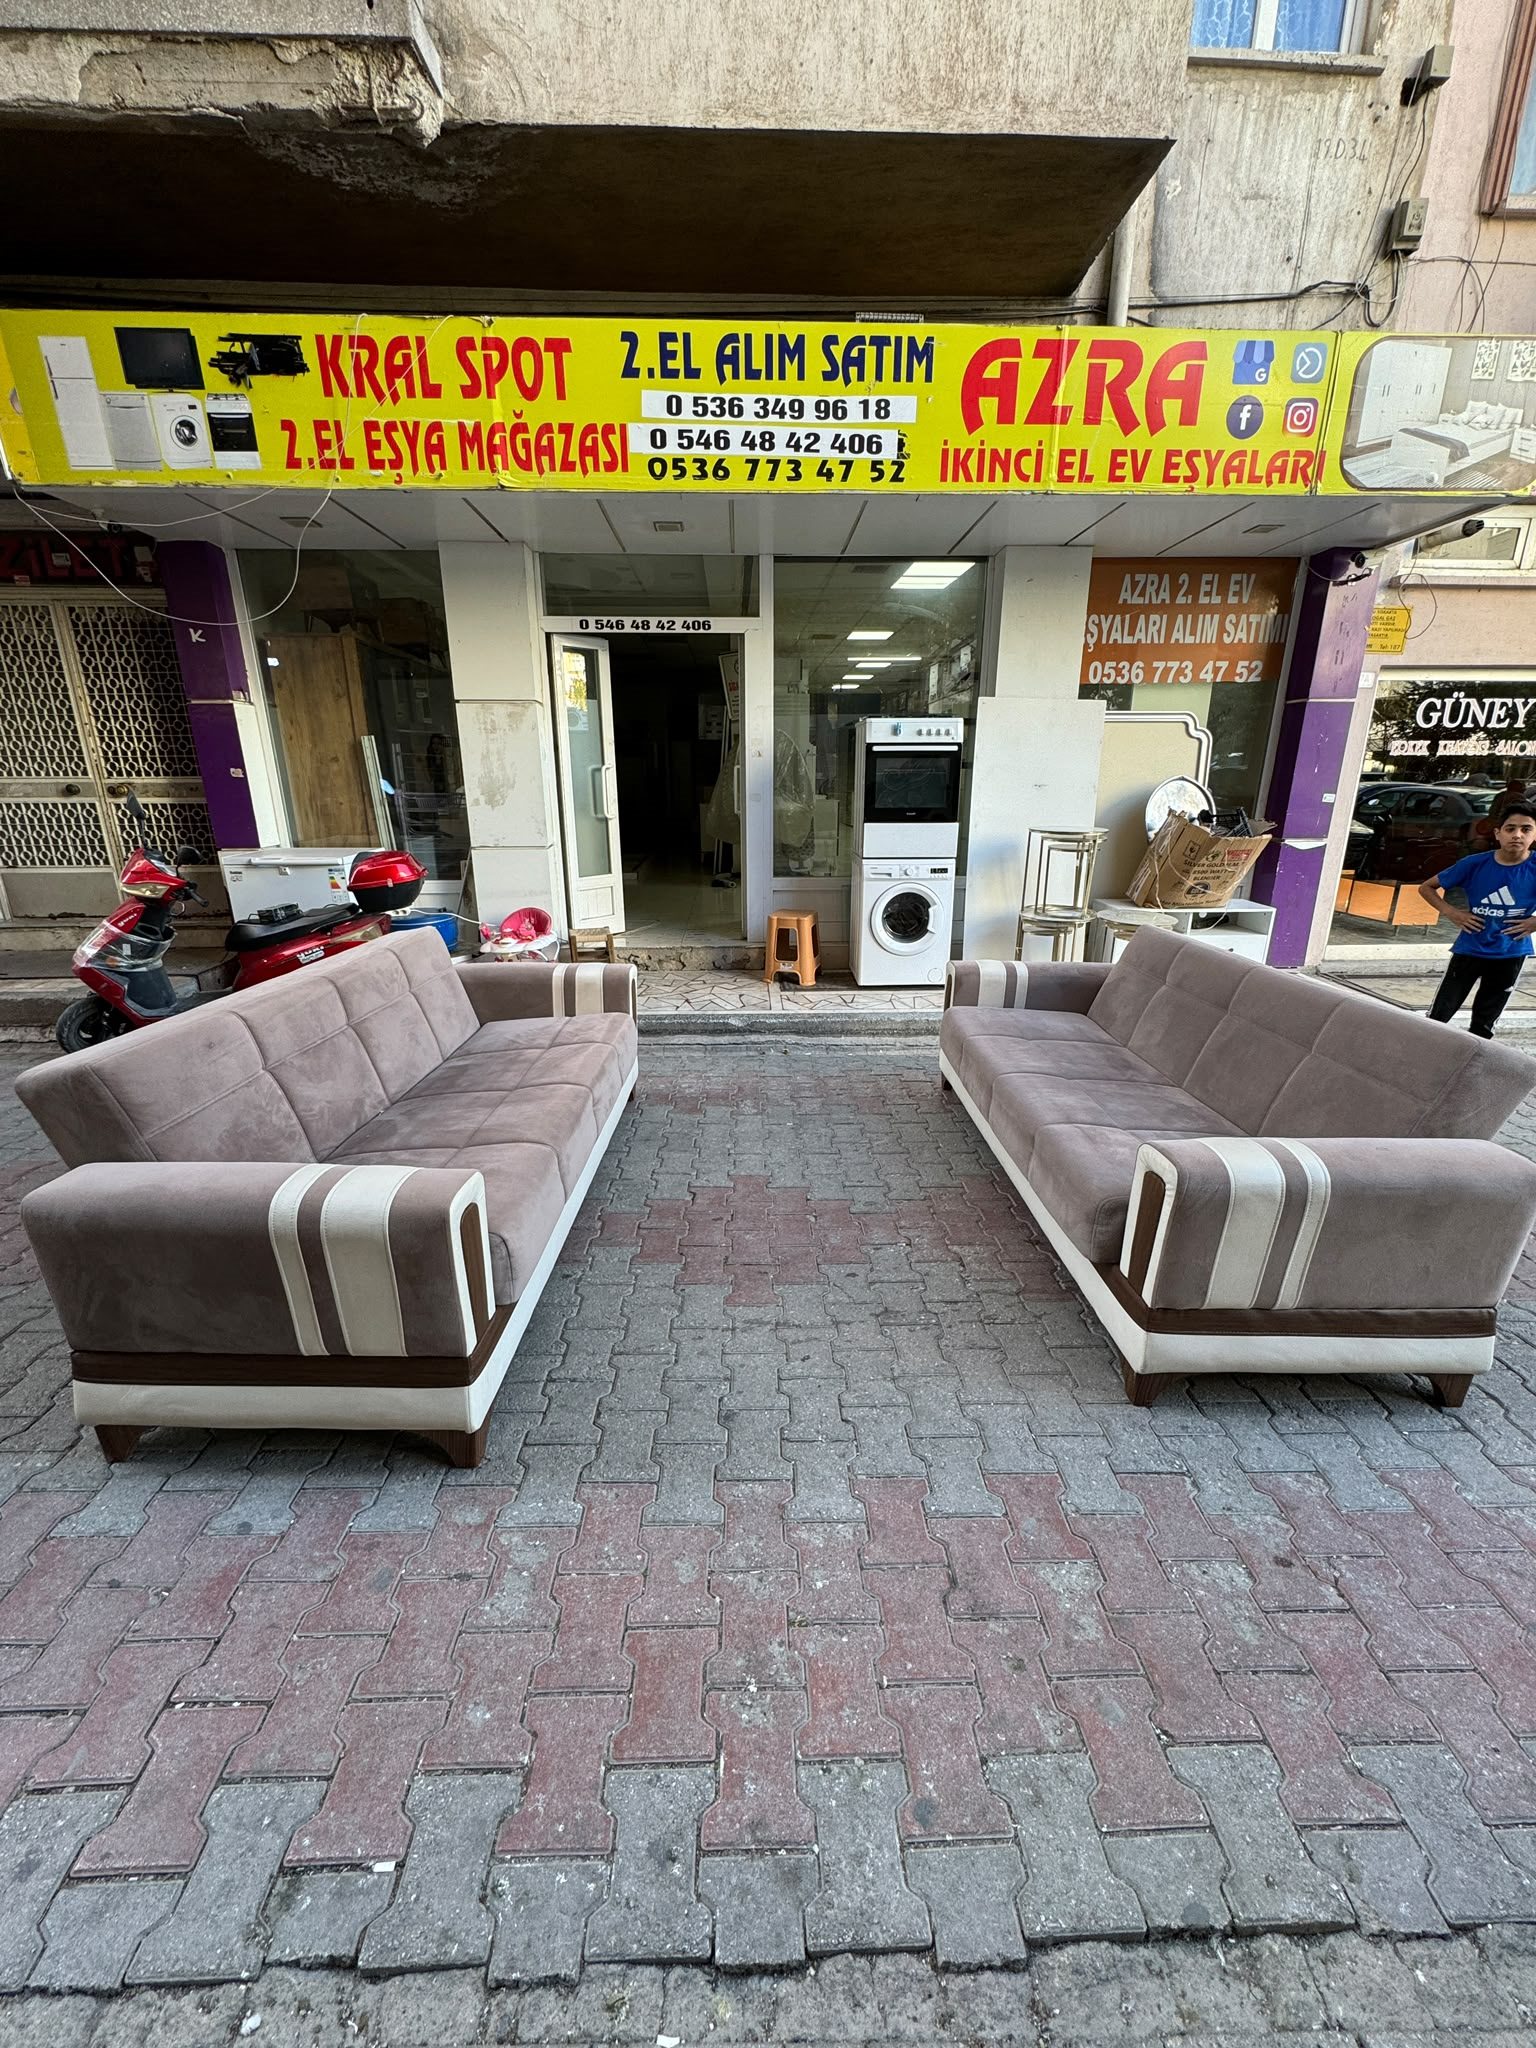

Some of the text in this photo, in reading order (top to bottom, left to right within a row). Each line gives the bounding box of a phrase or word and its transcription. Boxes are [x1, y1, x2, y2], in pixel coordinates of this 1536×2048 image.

[315, 334, 572, 406] KRAL SPOT
[620, 331, 935, 387] 2.EL ALIM SATIM
[1255, 368, 1267, 382] G
[960, 338, 1208, 437] AZRA
[665, 394, 891, 421] 0 536 349 96 18
[280, 409, 630, 483] 2.EL EŞYA MAĞAZASI
[650, 428, 883, 455] 0 546 48 42 406
[647, 457, 906, 483] 0536 773 47 52
[939, 439, 1327, 493] İKİNCİ EL EV EŞYALARI
[1118, 573, 1257, 605] AZRA 2. EL EV
[189, 627, 207, 643] K
[579, 619, 712, 631] 0 546 48 42 406
[1084, 614, 1168, 652] ŞYALARI
[1169, 614, 1220, 644] ALIM
[1088, 660, 1264, 685] 0536 773 47 52
[1415, 691, 1536, 729] GÜNEY
